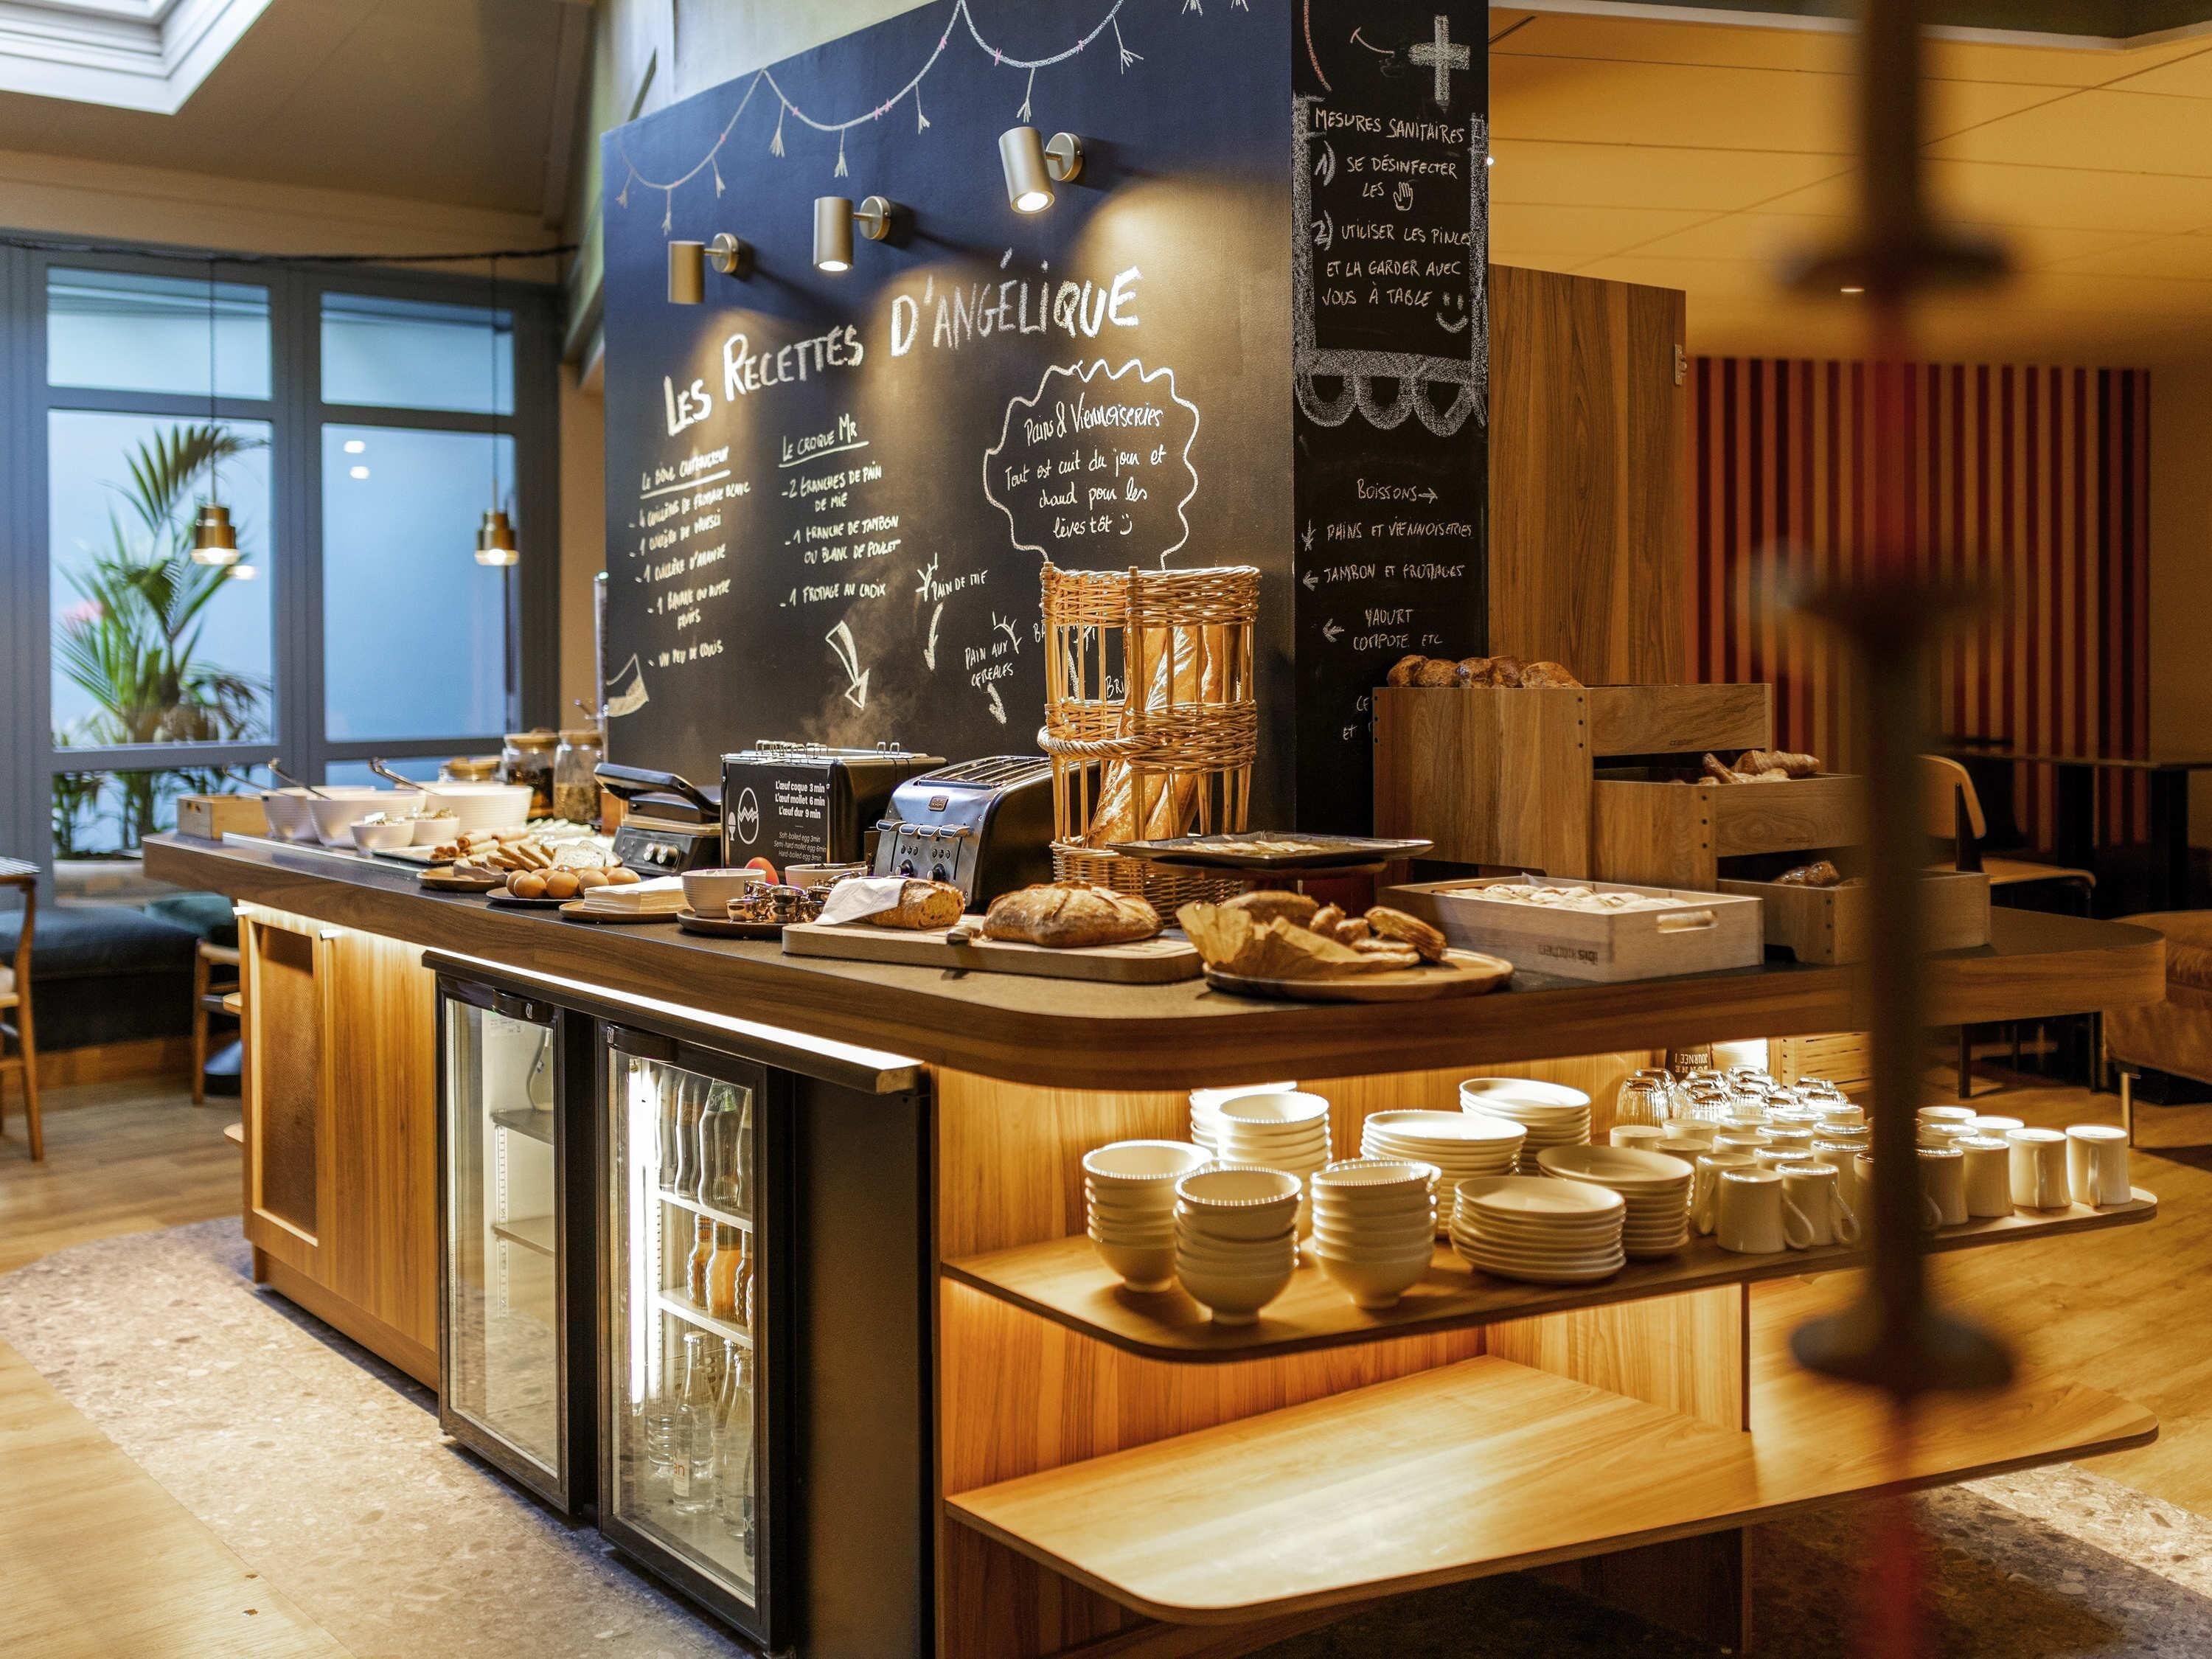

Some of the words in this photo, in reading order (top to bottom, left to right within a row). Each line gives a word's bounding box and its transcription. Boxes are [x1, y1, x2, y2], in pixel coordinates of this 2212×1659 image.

[1316, 108, 1381, 132] MESURES
[1386, 119, 1464, 144] SANITAIRES
[1348, 156, 1365, 173] SE
[1371, 154, 1457, 179] DÉSINFECTER
[1363, 182, 1384, 198] LES
[1342, 219, 1394, 240] UTILISER
[1404, 228, 1426, 244] LES
[1327, 262, 1340, 277] ET
[1346, 262, 1362, 277] LA
[1368, 260, 1420, 277] GARDER
[1426, 261, 1461, 276] AVEC
[1322, 291, 1357, 306] VOUS
[1387, 288, 1433, 307] TABLE
[665, 376, 712, 437] LES
[723, 324, 863, 402] RECETTES
[1057, 401, 1067, 437] &
[797, 431, 835, 455] CROQUE
[848, 470, 861, 485] DE
[1005, 464, 1030, 491] Tout
[1037, 459, 1052, 479] est
[1088, 446, 1107, 471] du
[1150, 444, 1166, 465] et
[1039, 481, 1077, 508] chaud
[1088, 487, 1117, 511] pour
[1125, 477, 1147, 502] les
[815, 498, 827, 512] DE
[848, 520, 860, 535] DE
[1327, 521, 1362, 541] PAINS
[1371, 524, 1385, 537] ET
[804, 550, 818, 564] OU
[821, 546, 849, 563] BLANC
[853, 543, 866, 560] DE
[867, 539, 902, 557] POULET
[1324, 563, 1376, 583] JAMBON
[1385, 566, 1396, 577] ET
[802, 582, 840, 604] FROMAGE
[955, 577, 965, 591] DE
[1365, 608, 1413, 627] YAOURT
[1422, 634, 1443, 647] ETC
[965, 646, 986, 670] PAIN
[992, 640, 1008, 657] AUX
[791, 783, 807, 793] coque
[810, 783, 813, 792] 3
[814, 783, 825, 793] min
[790, 795, 807, 804] mollet
[810, 796, 813, 805] 6
[814, 796, 825, 806] min
[794, 807, 803, 817] dur
[805, 809, 809, 818] 9
[810, 809, 821, 818] min
